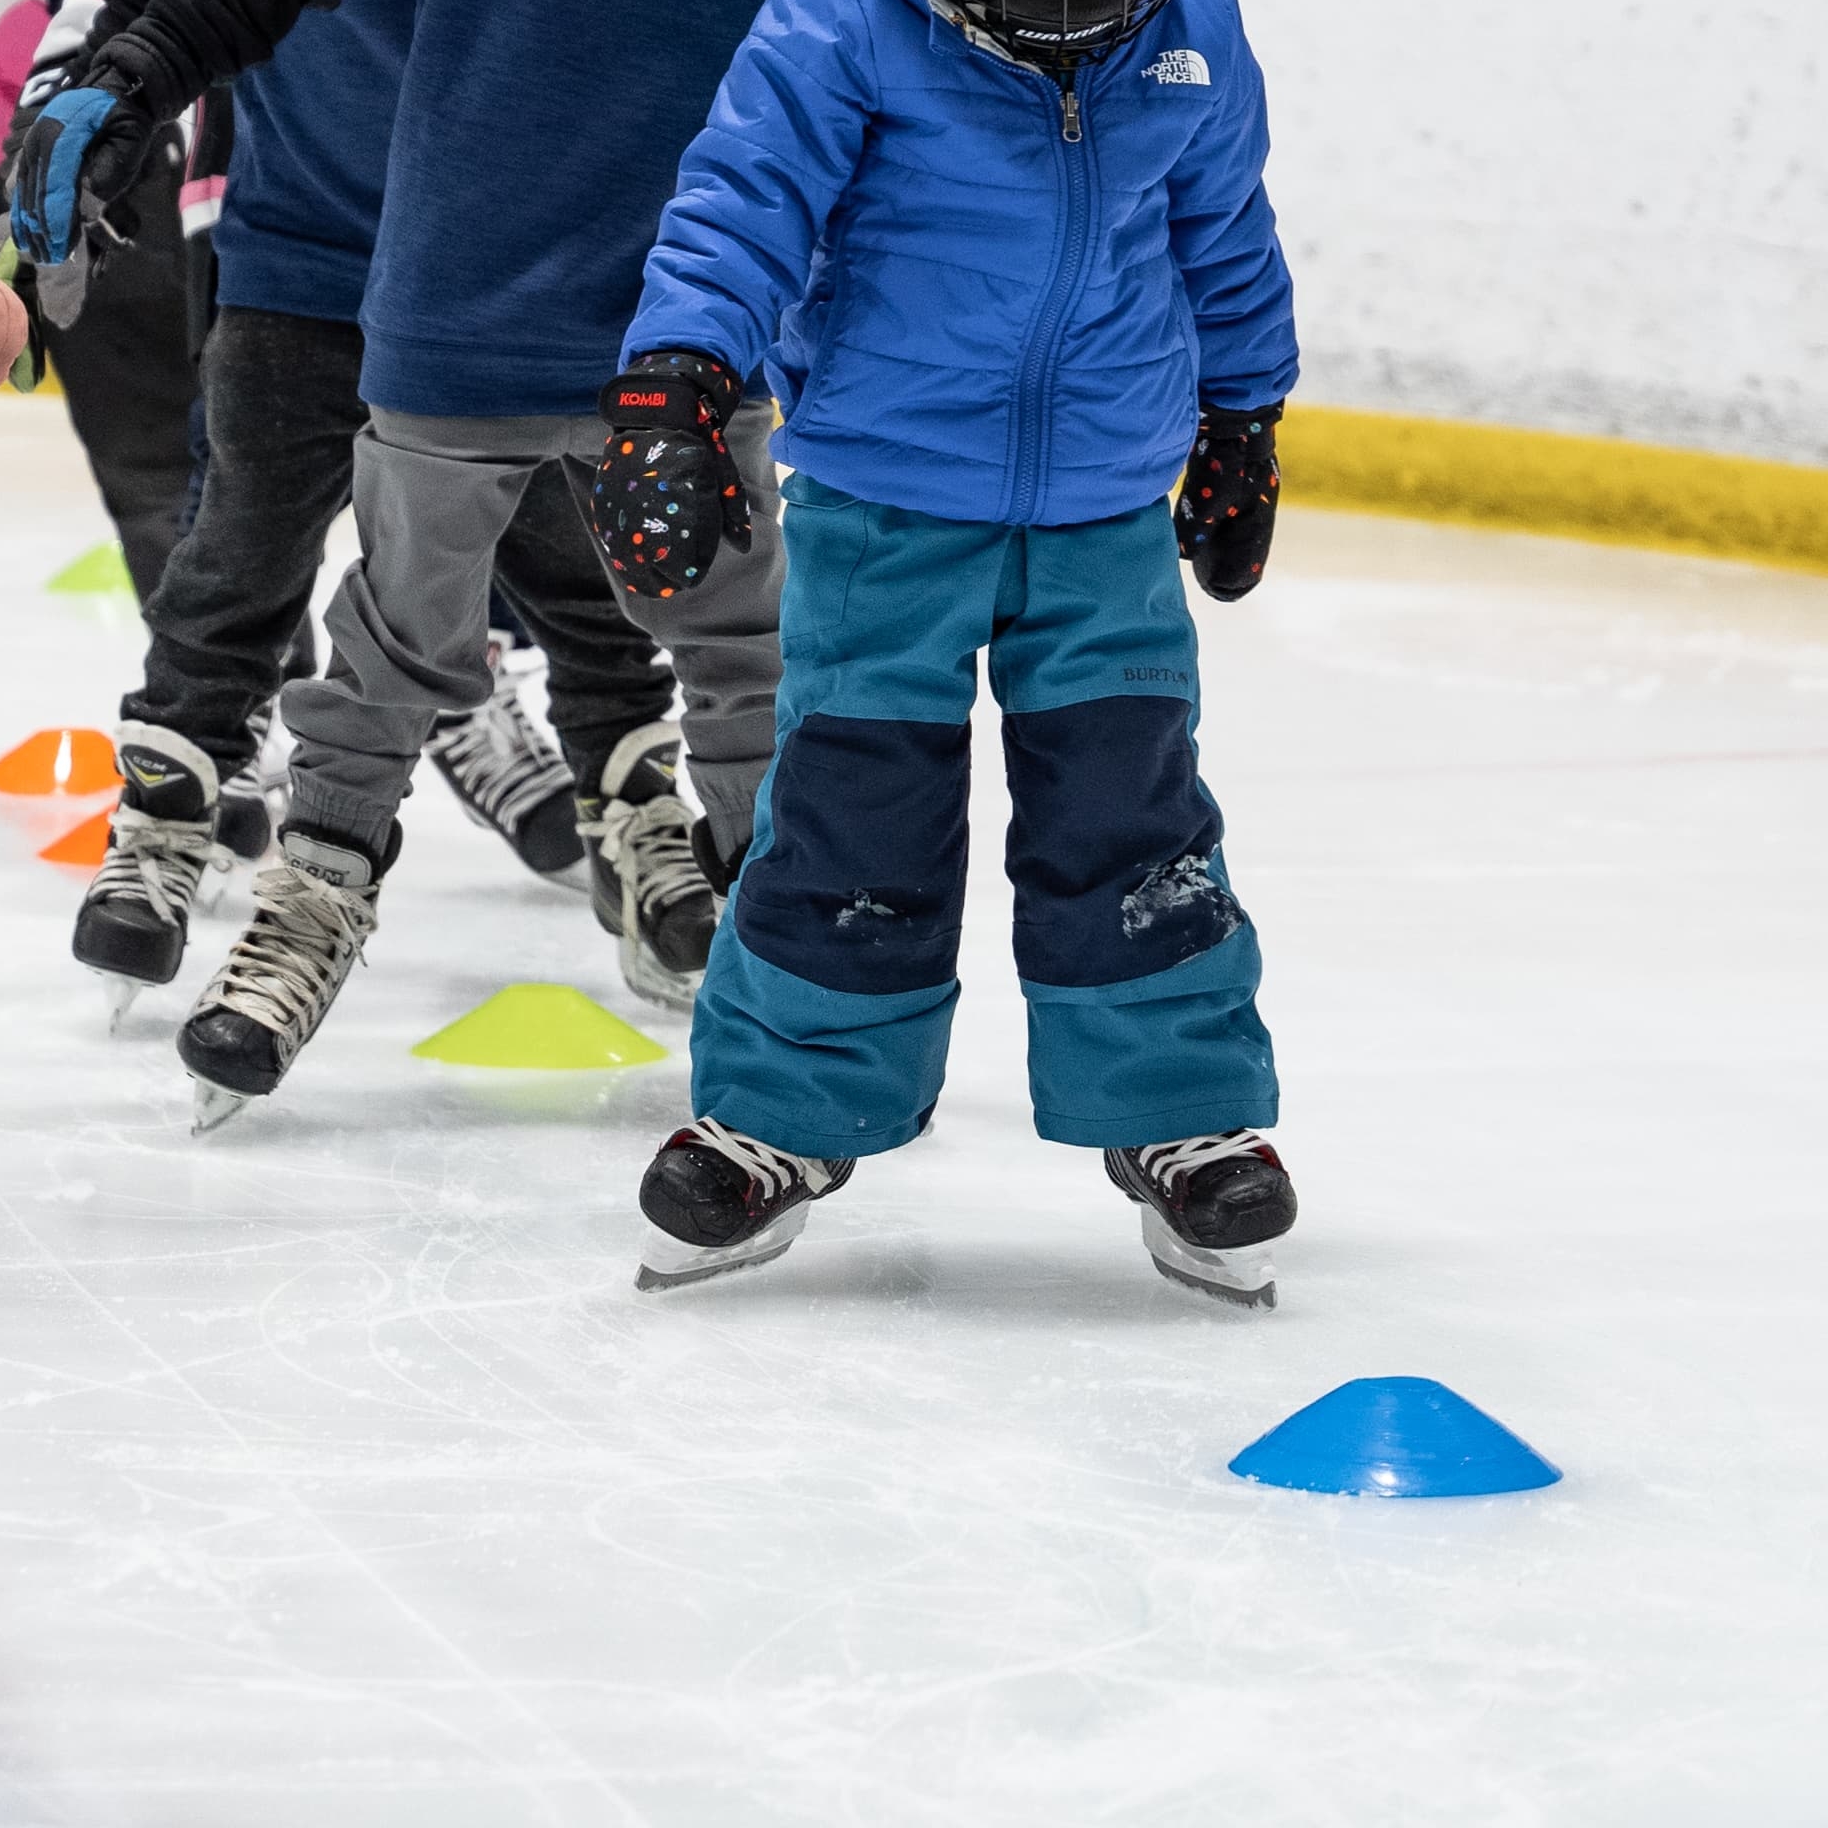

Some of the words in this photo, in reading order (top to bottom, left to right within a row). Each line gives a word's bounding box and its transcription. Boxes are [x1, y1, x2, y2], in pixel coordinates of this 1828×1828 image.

[1158, 50, 1187, 62] THE
[1141, 61, 1189, 79] NORTH
[1157, 72, 1191, 85] FACE
[619, 393, 666, 406] KOMBI
